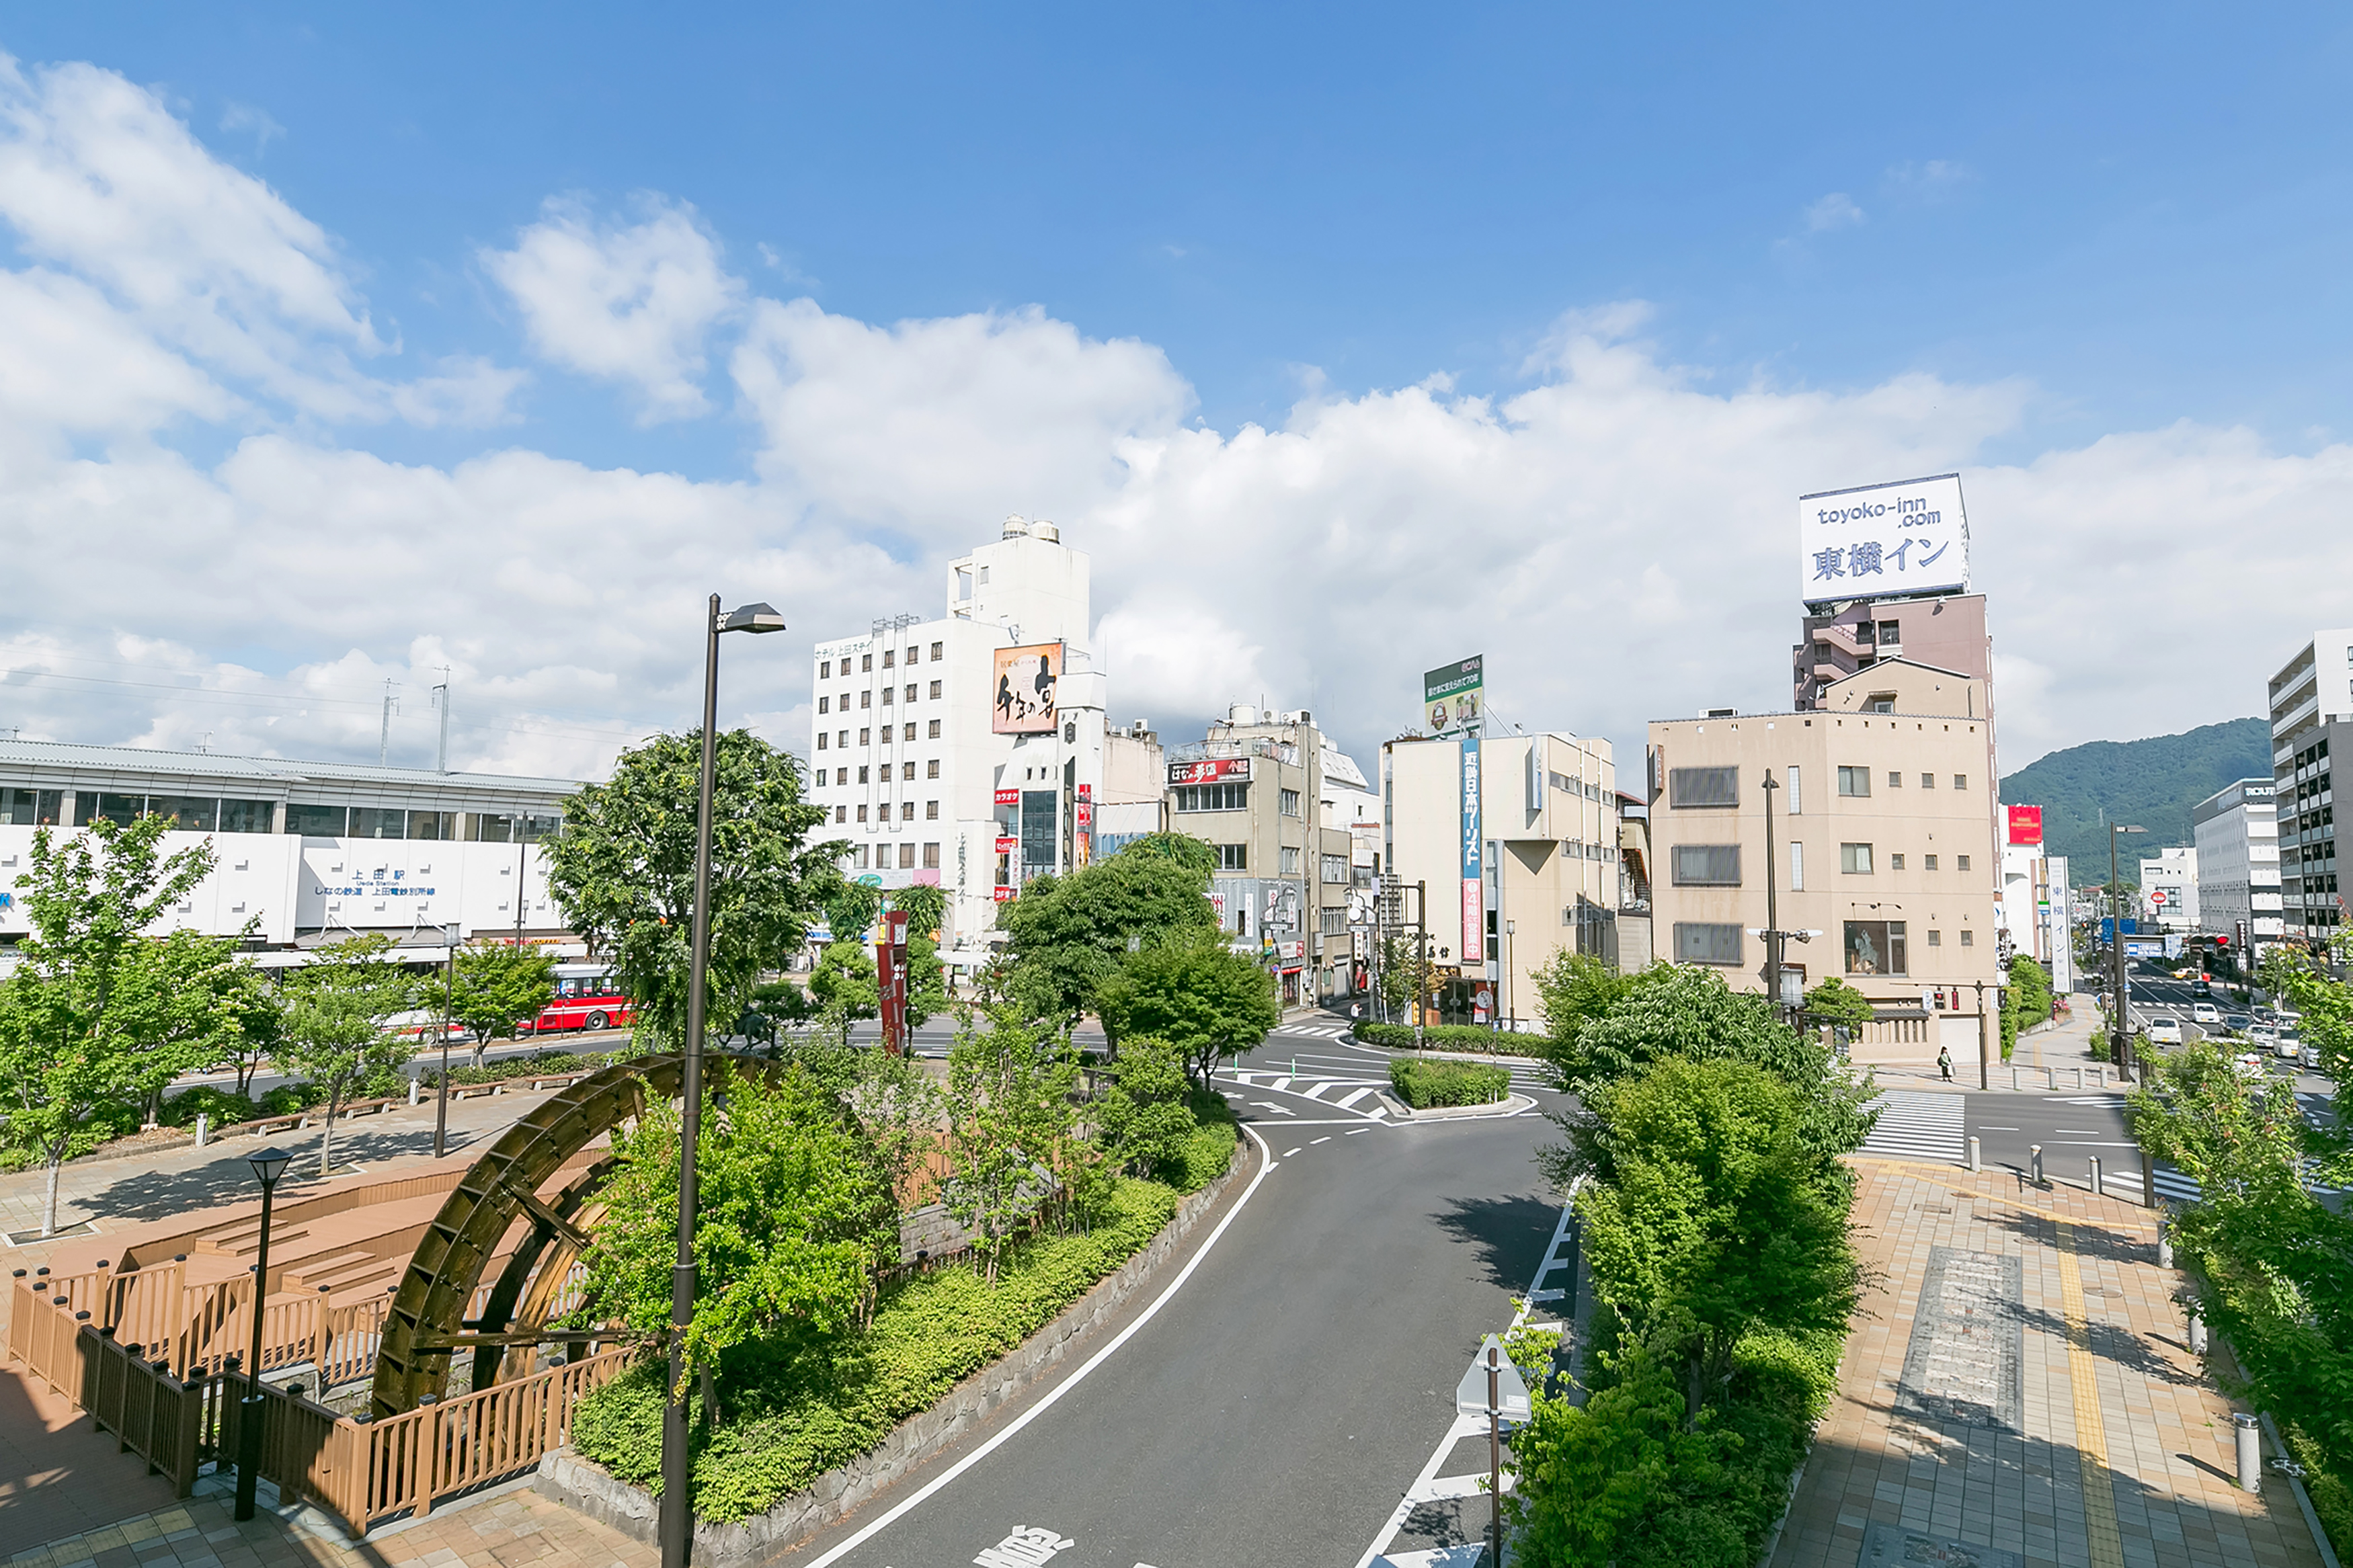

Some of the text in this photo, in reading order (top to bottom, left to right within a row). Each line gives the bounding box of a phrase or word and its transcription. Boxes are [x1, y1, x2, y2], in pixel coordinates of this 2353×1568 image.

[1817, 497, 1927, 524] toyoko-inn
[1897, 509, 1942, 528] .com
[1812, 538, 1950, 581] 東横イン
[995, 792, 1018, 801] カラオケ
[1464, 751, 1478, 866] 近畿日本ツーリスト
[352, 869, 405, 880] 上田駅
[2052, 886, 2066, 952] 東横イン
